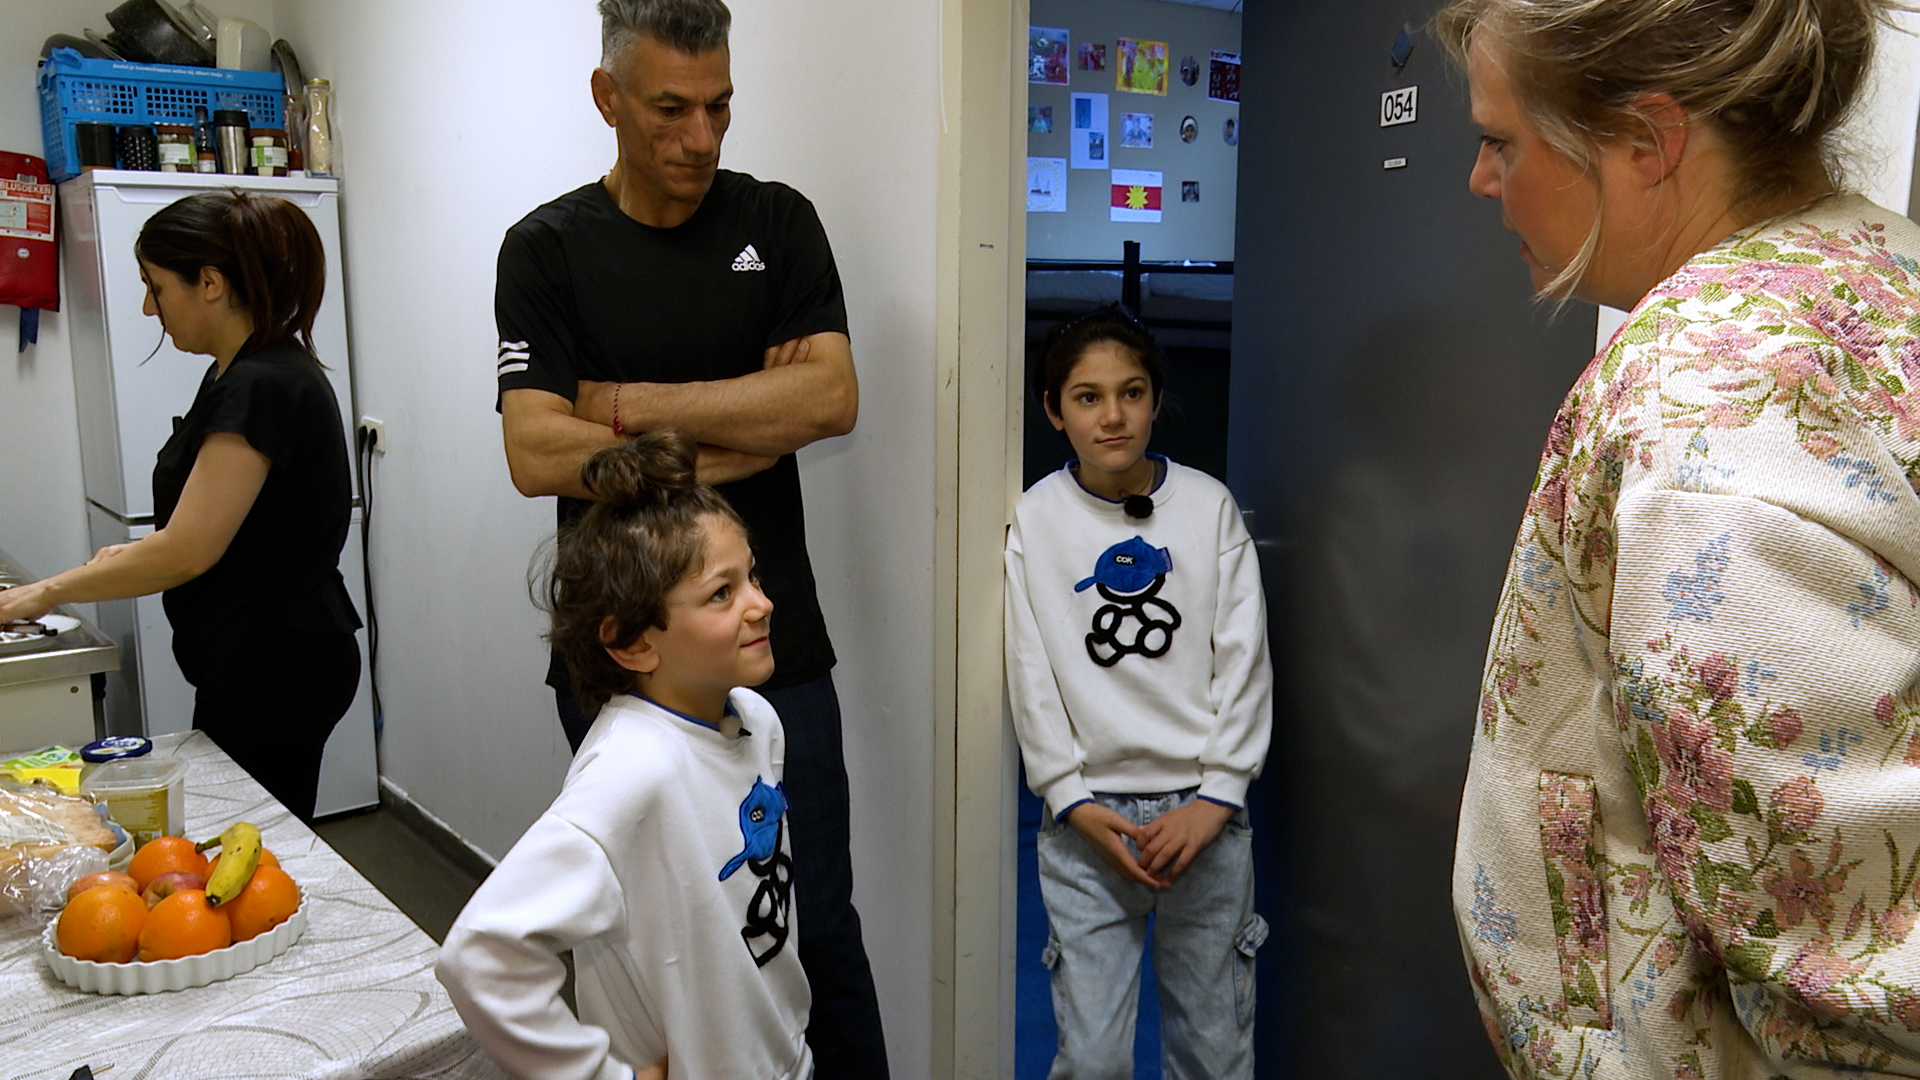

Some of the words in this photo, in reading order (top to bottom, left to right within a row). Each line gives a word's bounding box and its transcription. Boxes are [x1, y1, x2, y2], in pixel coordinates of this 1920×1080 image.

[1384, 91, 1414, 122] 054
[0, 181, 52, 194] BLUSDEKEN
[731, 260, 766, 272] adidas
